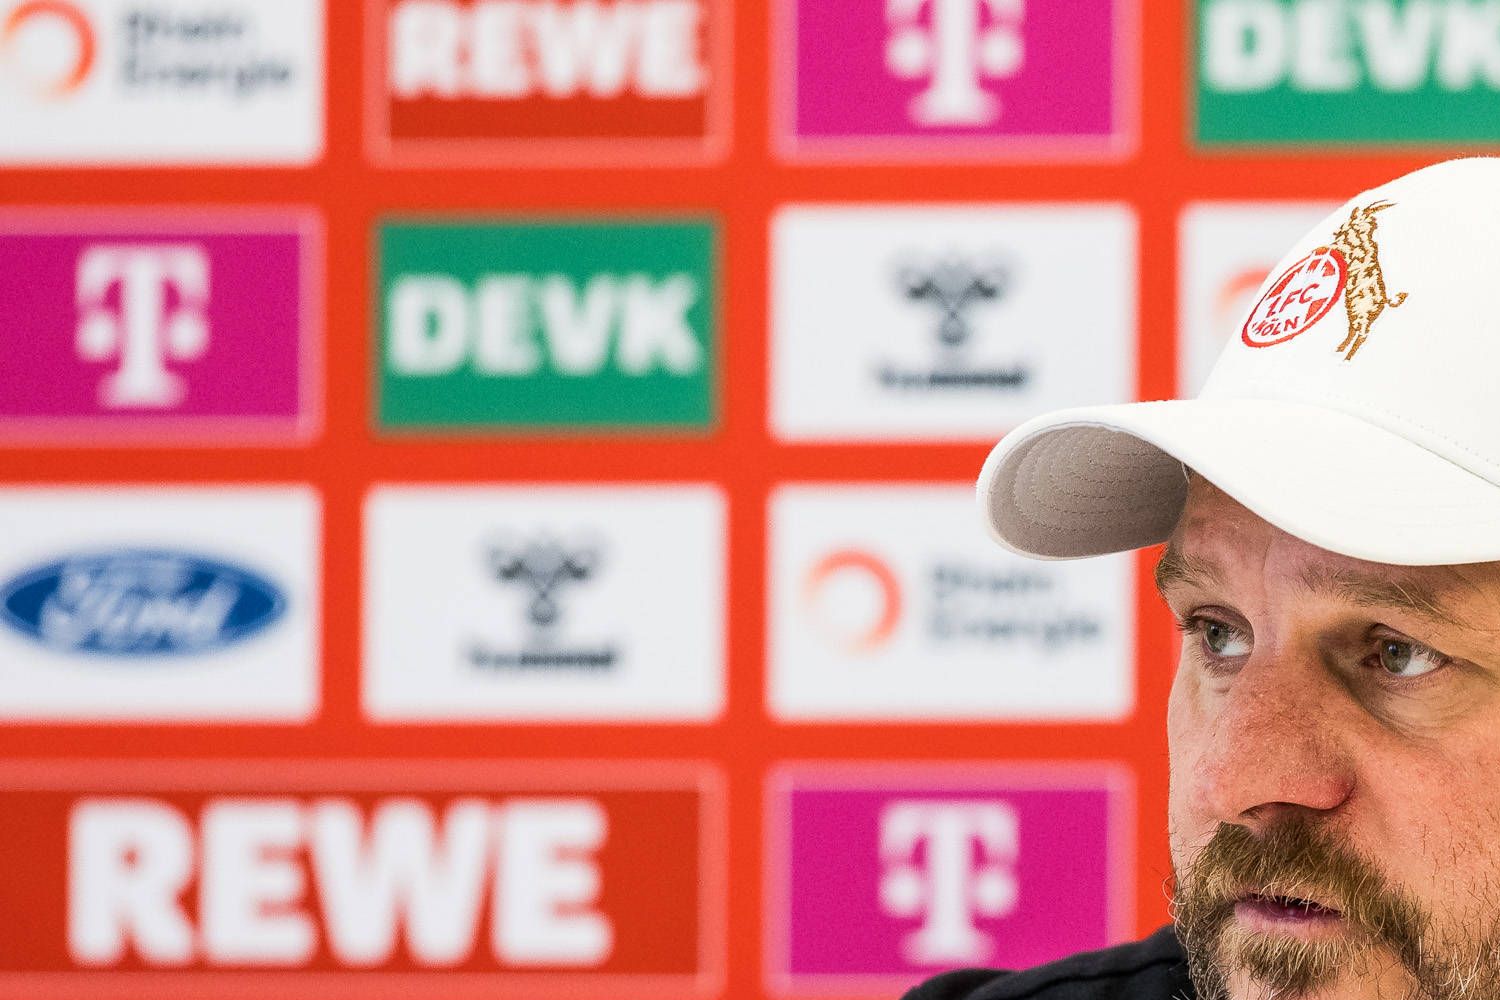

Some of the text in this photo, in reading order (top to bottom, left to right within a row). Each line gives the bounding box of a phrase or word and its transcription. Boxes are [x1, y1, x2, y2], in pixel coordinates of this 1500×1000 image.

[387, 0, 707, 96] REWE
[386, 275, 701, 375] DEVK
[67, 798, 613, 967] REWE
